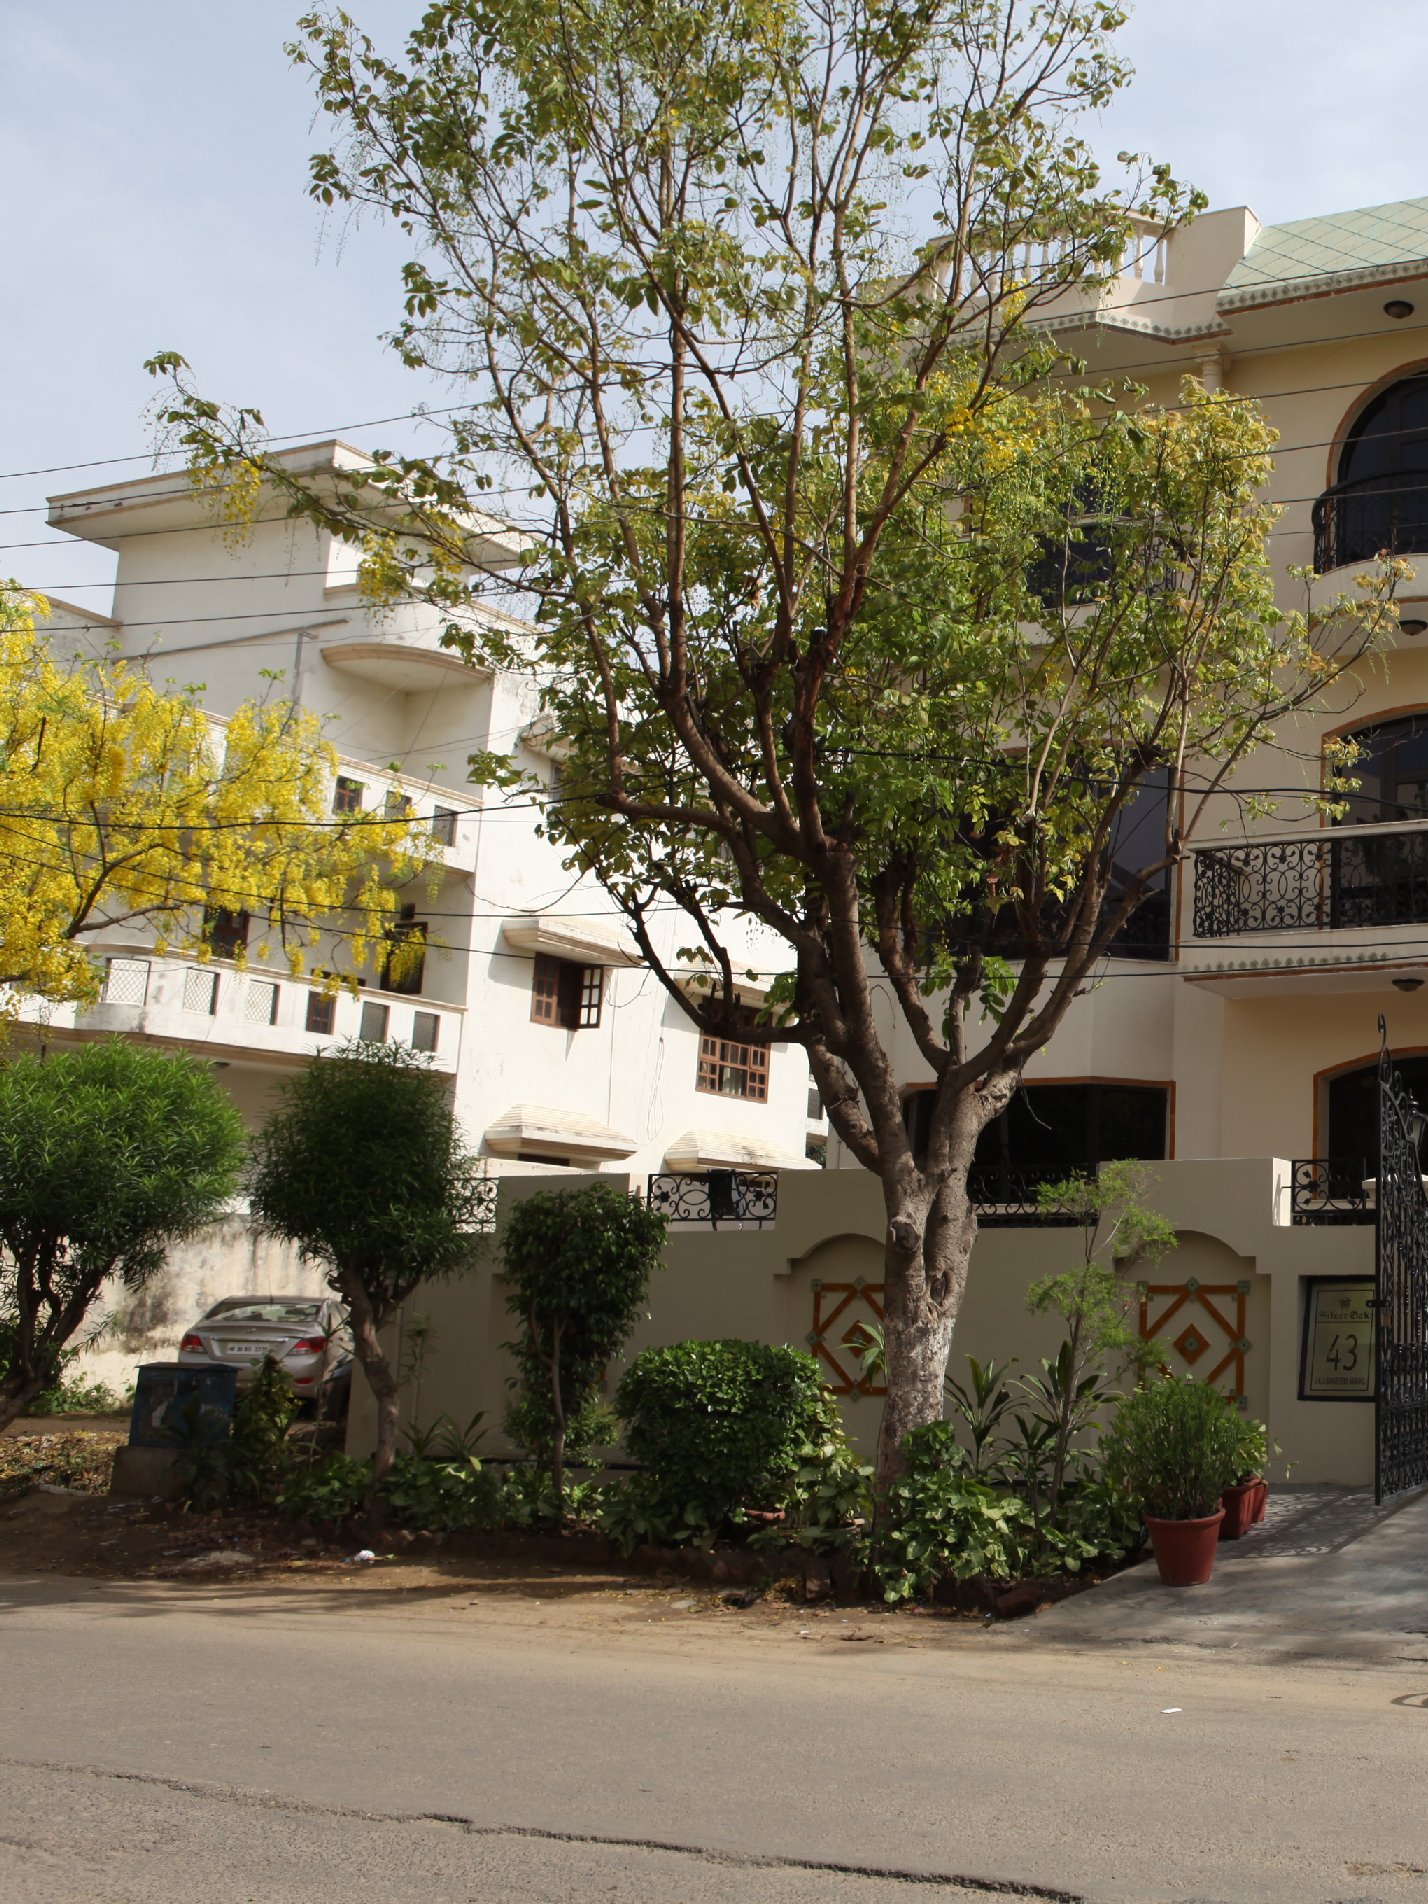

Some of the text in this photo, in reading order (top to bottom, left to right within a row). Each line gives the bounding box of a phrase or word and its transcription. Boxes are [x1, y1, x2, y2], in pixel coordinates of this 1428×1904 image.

[1319, 1310, 1370, 1320] Silver Oak
[1326, 1334, 1358, 1371] 43
